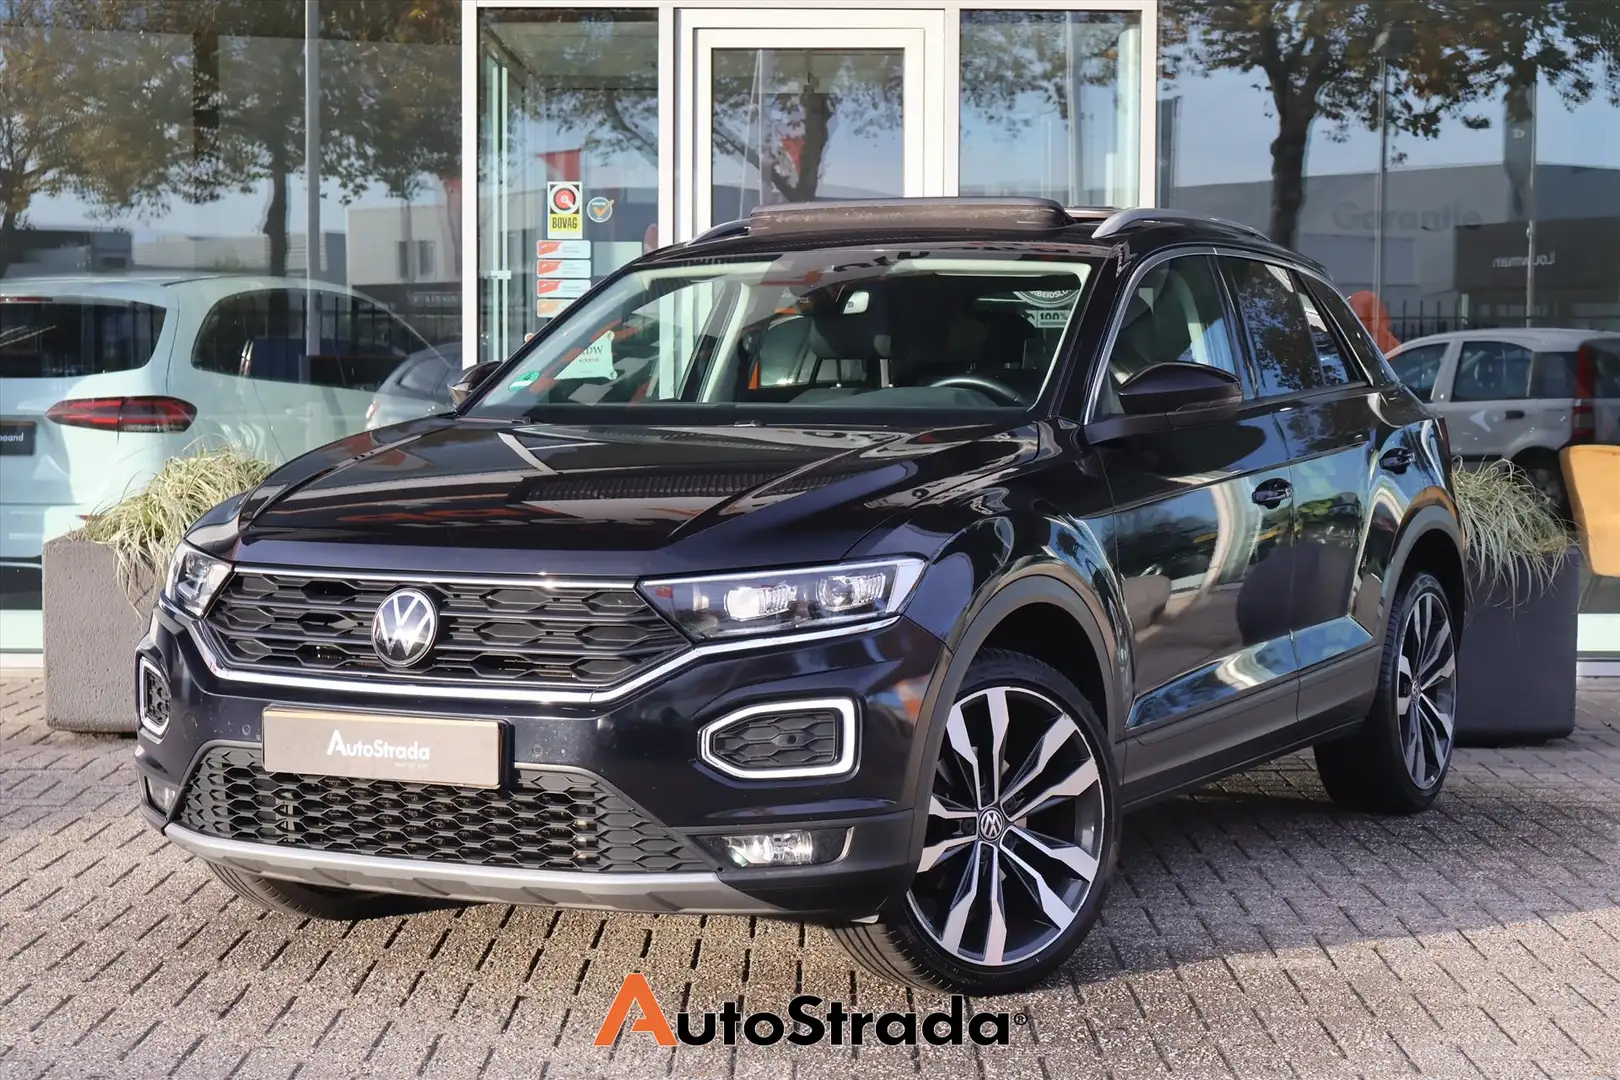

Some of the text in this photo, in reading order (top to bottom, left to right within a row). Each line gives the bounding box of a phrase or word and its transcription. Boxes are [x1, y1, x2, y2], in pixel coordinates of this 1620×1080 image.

[551, 216, 578, 230] BOVAG
[0, 431, 25, 443] aand
[326, 729, 431, 761] AutoStrada
